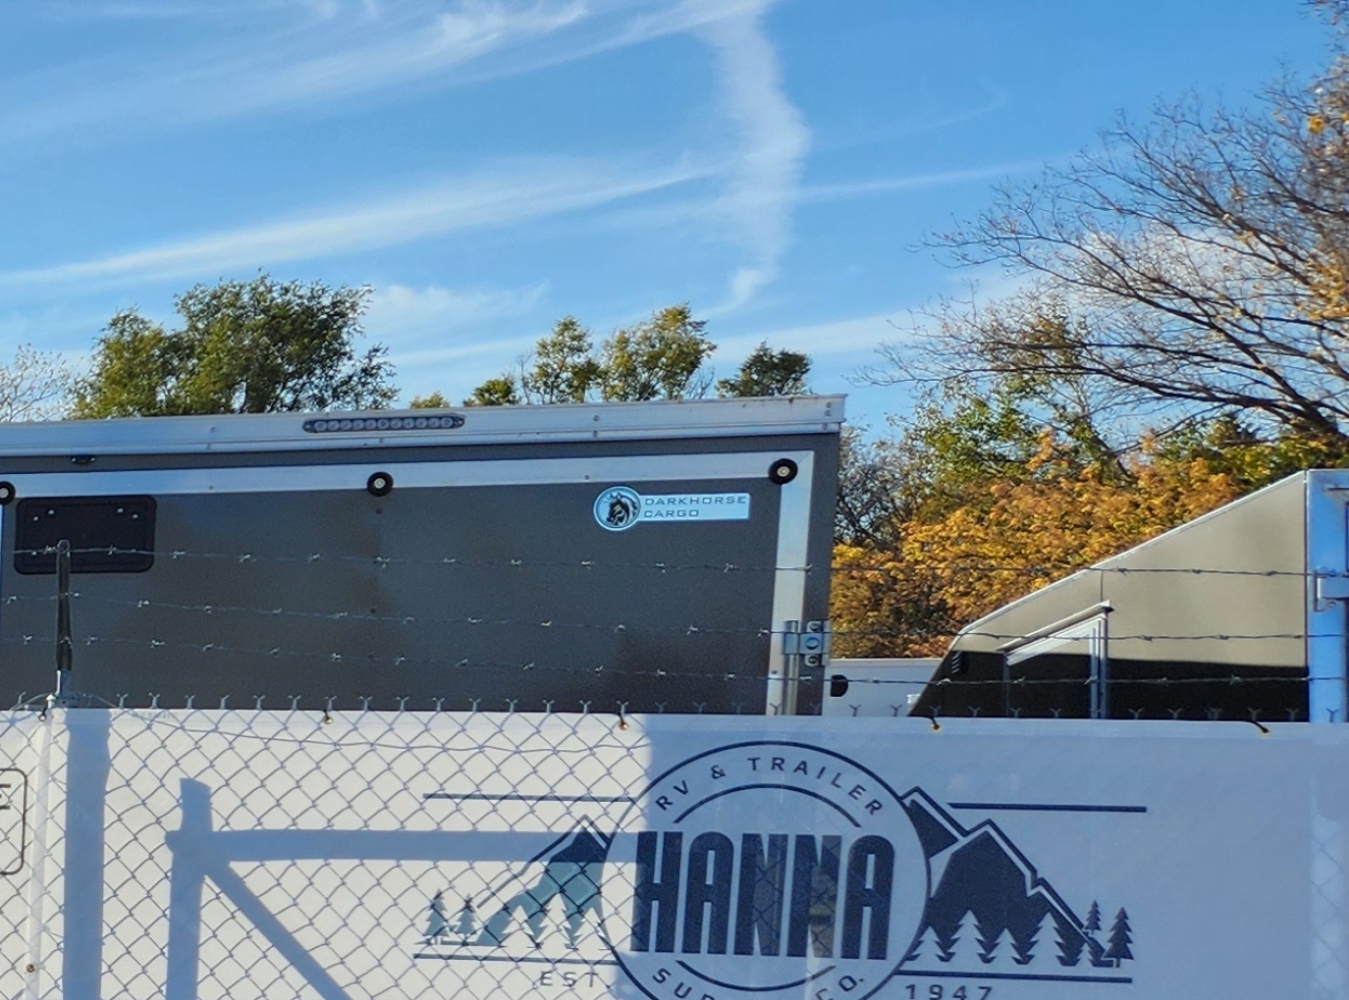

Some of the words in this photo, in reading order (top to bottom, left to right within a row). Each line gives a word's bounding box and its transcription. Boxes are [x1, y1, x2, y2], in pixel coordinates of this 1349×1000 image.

[643, 509, 700, 518] CARGO
[644, 496, 747, 506] DARKHORSE
[655, 780, 690, 813] RV
[710, 765, 727, 780] &
[748, 756, 883, 816] TRAILER
[630, 831, 896, 961] HANNA
